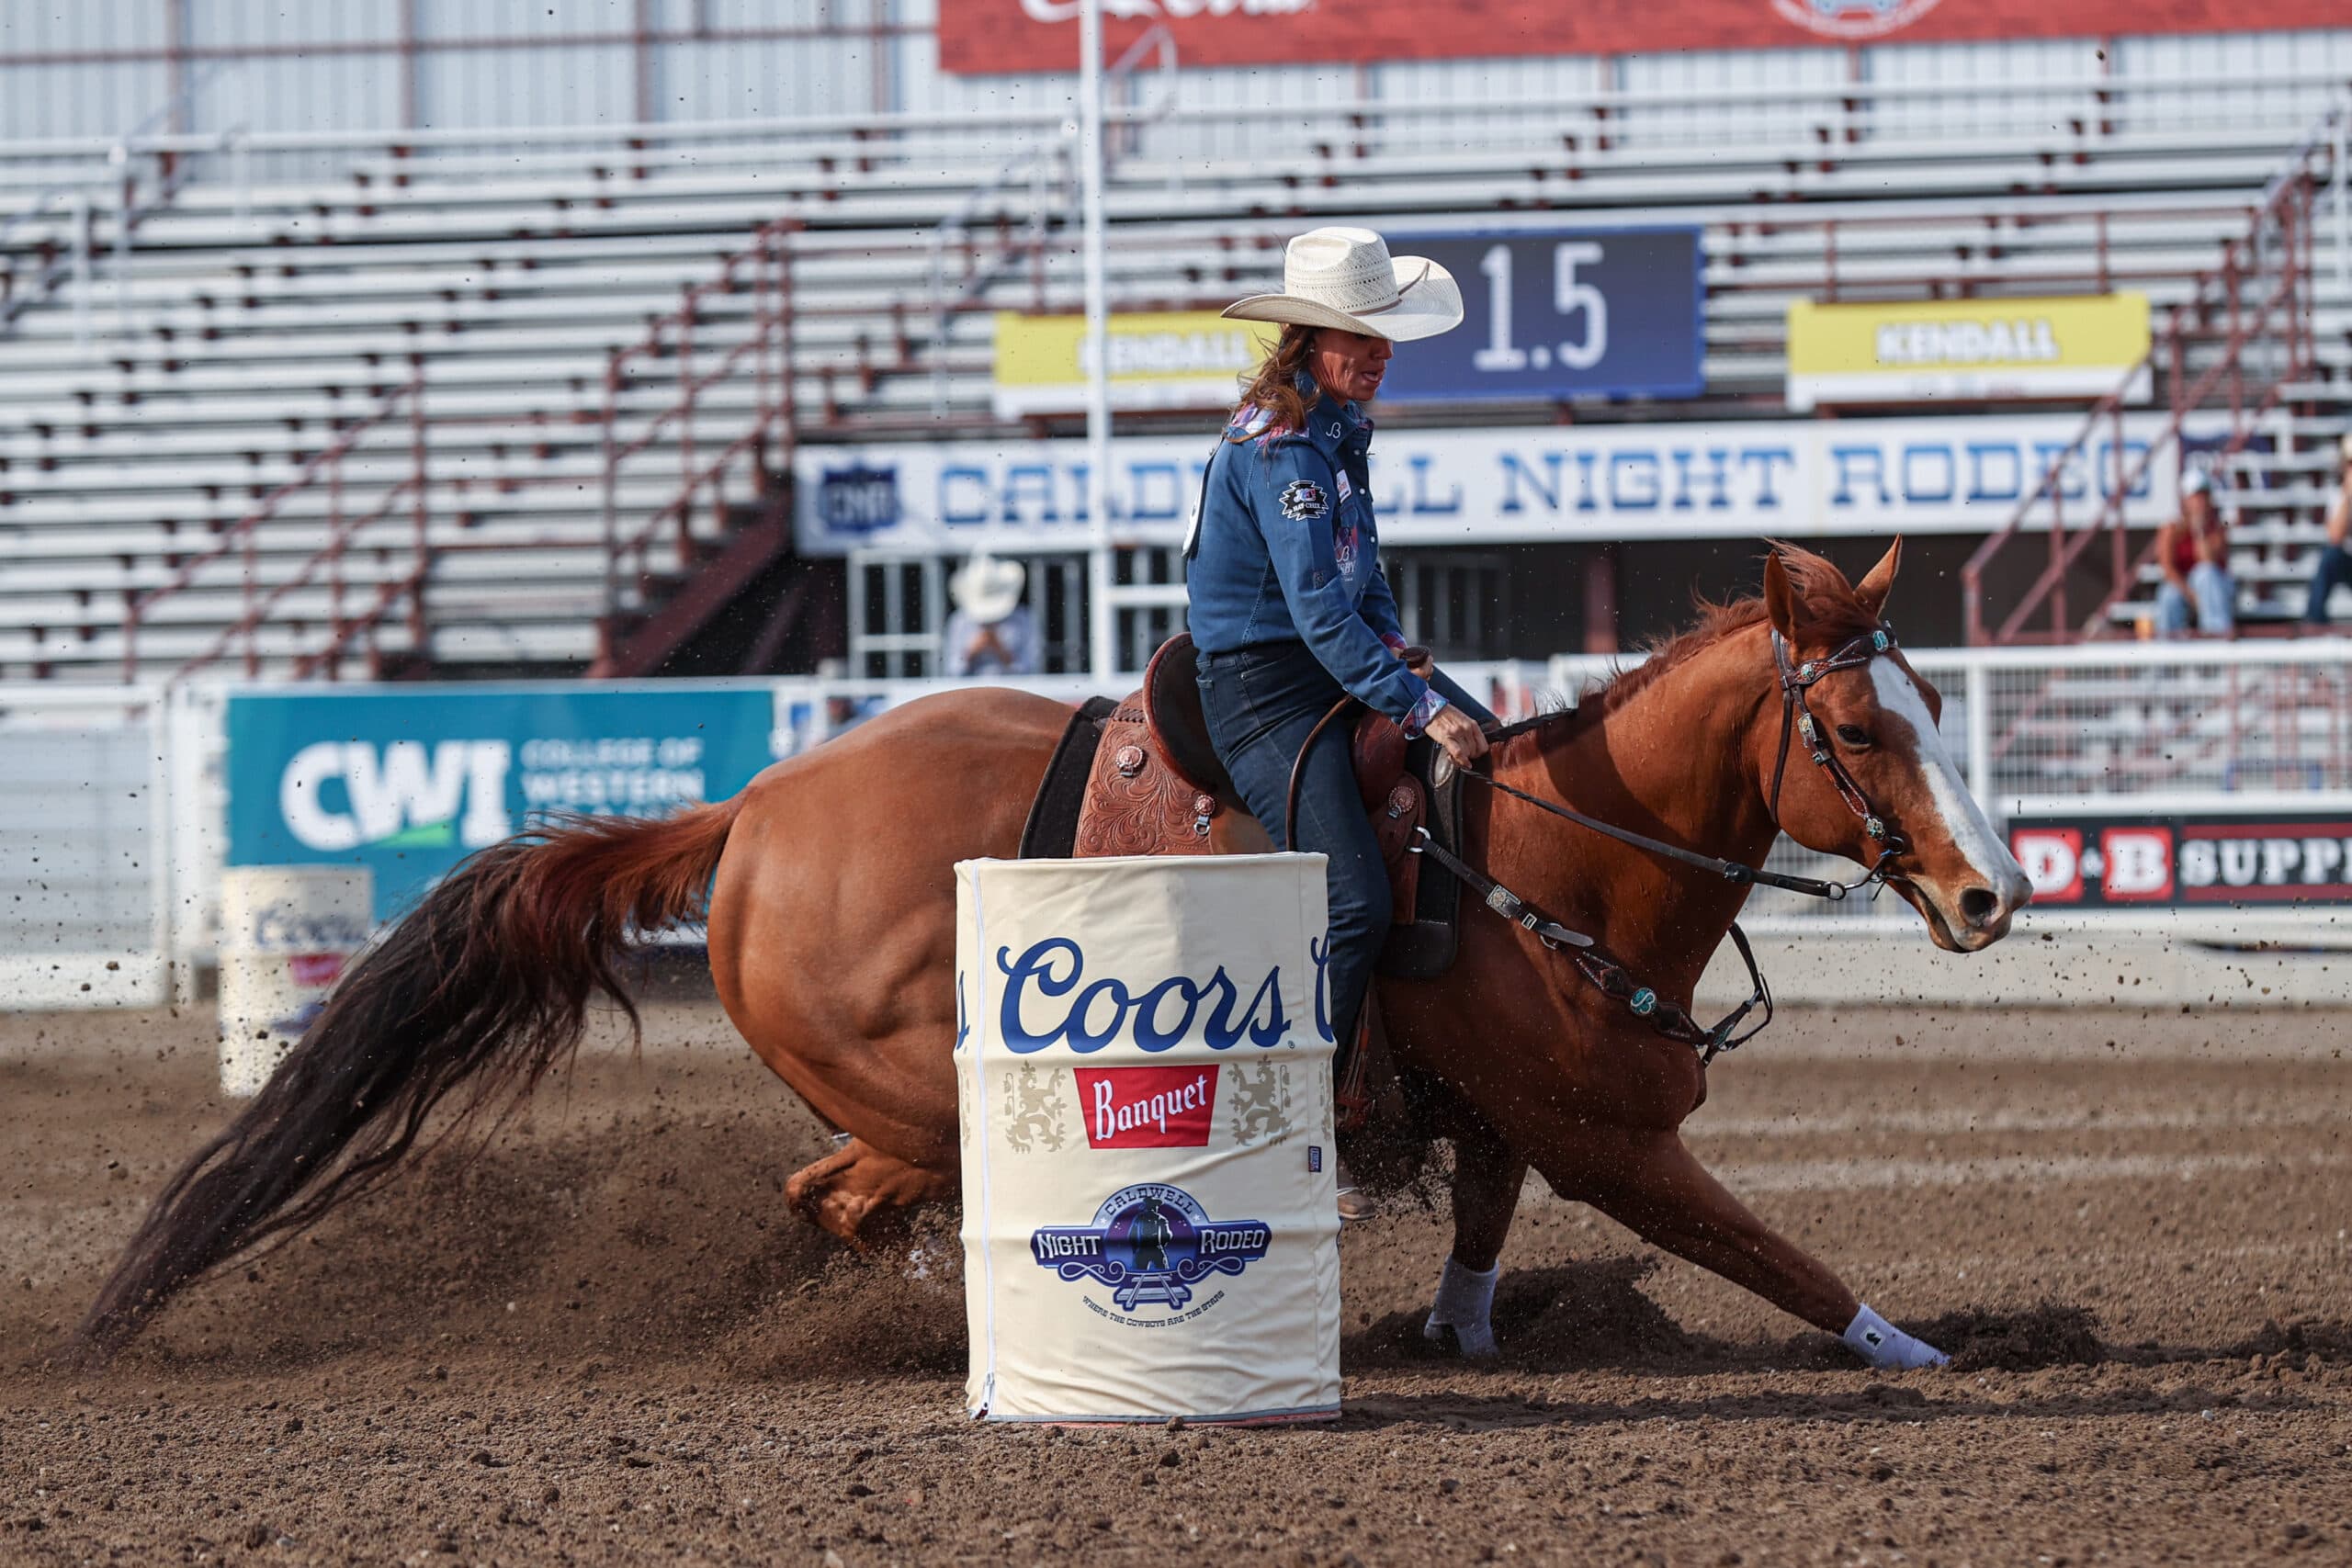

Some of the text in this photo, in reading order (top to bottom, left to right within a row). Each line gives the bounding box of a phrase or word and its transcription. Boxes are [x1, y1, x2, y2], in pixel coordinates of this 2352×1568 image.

[1472, 241, 1608, 371] 1.5
[1875, 317, 2061, 363] KENDALL
[1498, 444, 1798, 514] NIGHT
[1828, 441, 2153, 506] RODEO
[520, 736, 705, 770] COLLEGE OF
[279, 738, 512, 852] CWI
[520, 768, 706, 806] WESTERN
[2109, 831, 2169, 893] B
[2178, 837, 2352, 887] SUPP
[997, 937, 1292, 1054] Coors
[1092, 1073, 1209, 1142] Banquet
[1104, 1186, 1193, 1216] CALDWELL
[1036, 1229, 1266, 1258] NIGHT RODEO
[1082, 1290, 1226, 1328] WHERE THE COWBOYS ARE THE STARS
